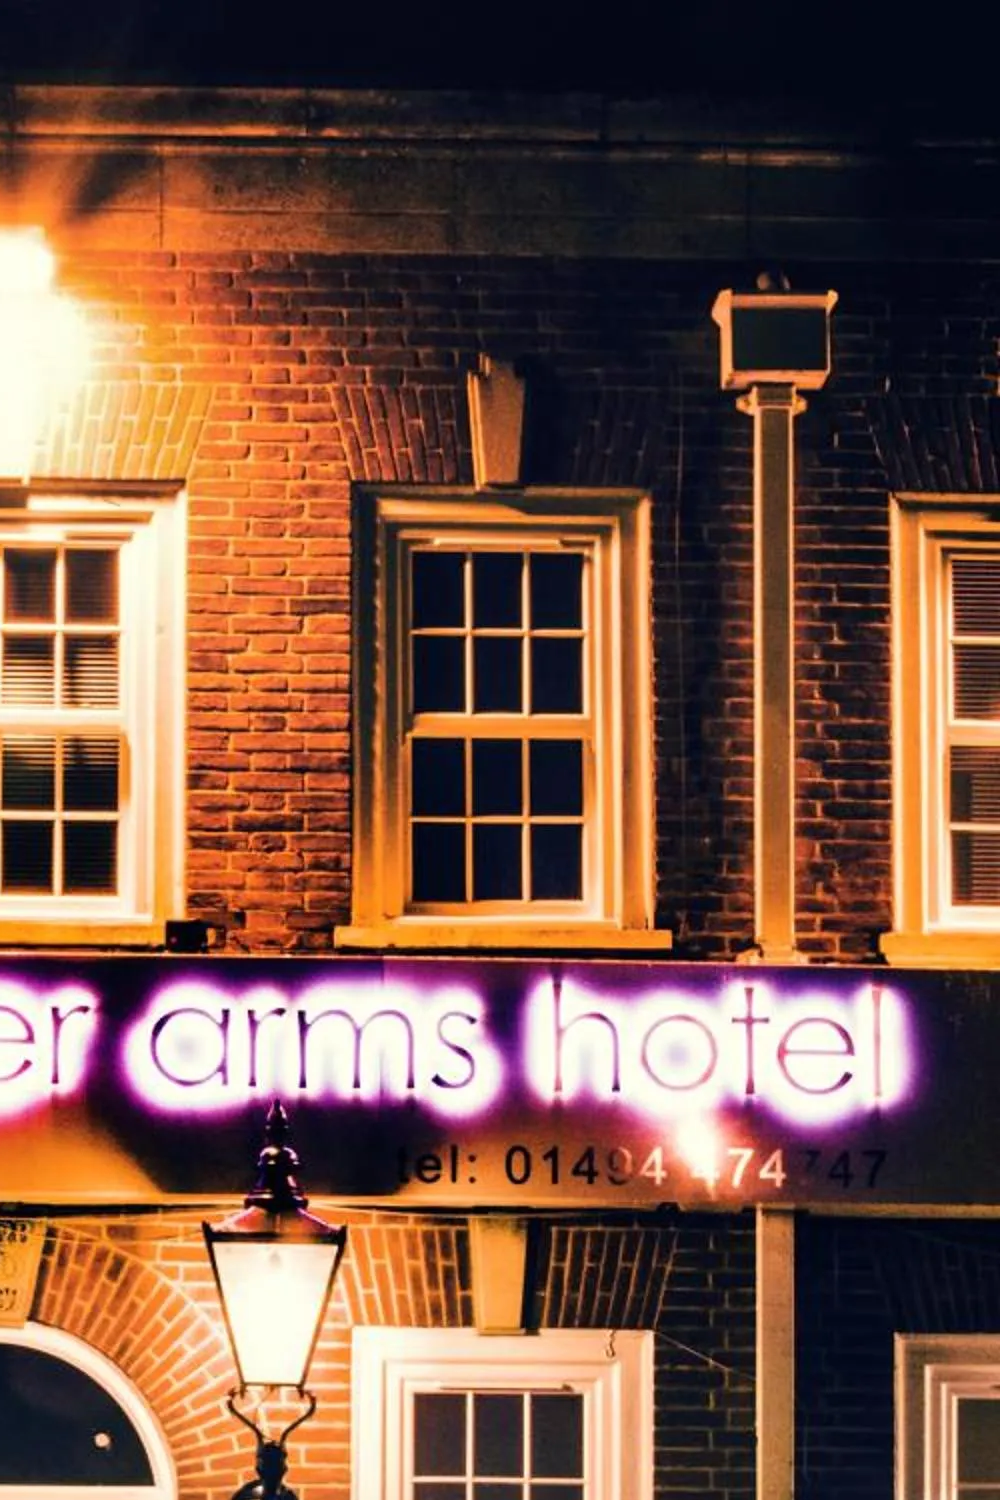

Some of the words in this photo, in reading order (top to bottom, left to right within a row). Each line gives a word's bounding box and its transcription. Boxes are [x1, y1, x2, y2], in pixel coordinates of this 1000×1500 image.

[150, 1006, 479, 1089] arms
[553, 977, 886, 1096] hotel
[398, 1143, 477, 1184] tel:
[504, 1145, 667, 1186] 01494
[798, 1149, 888, 1188] 747
